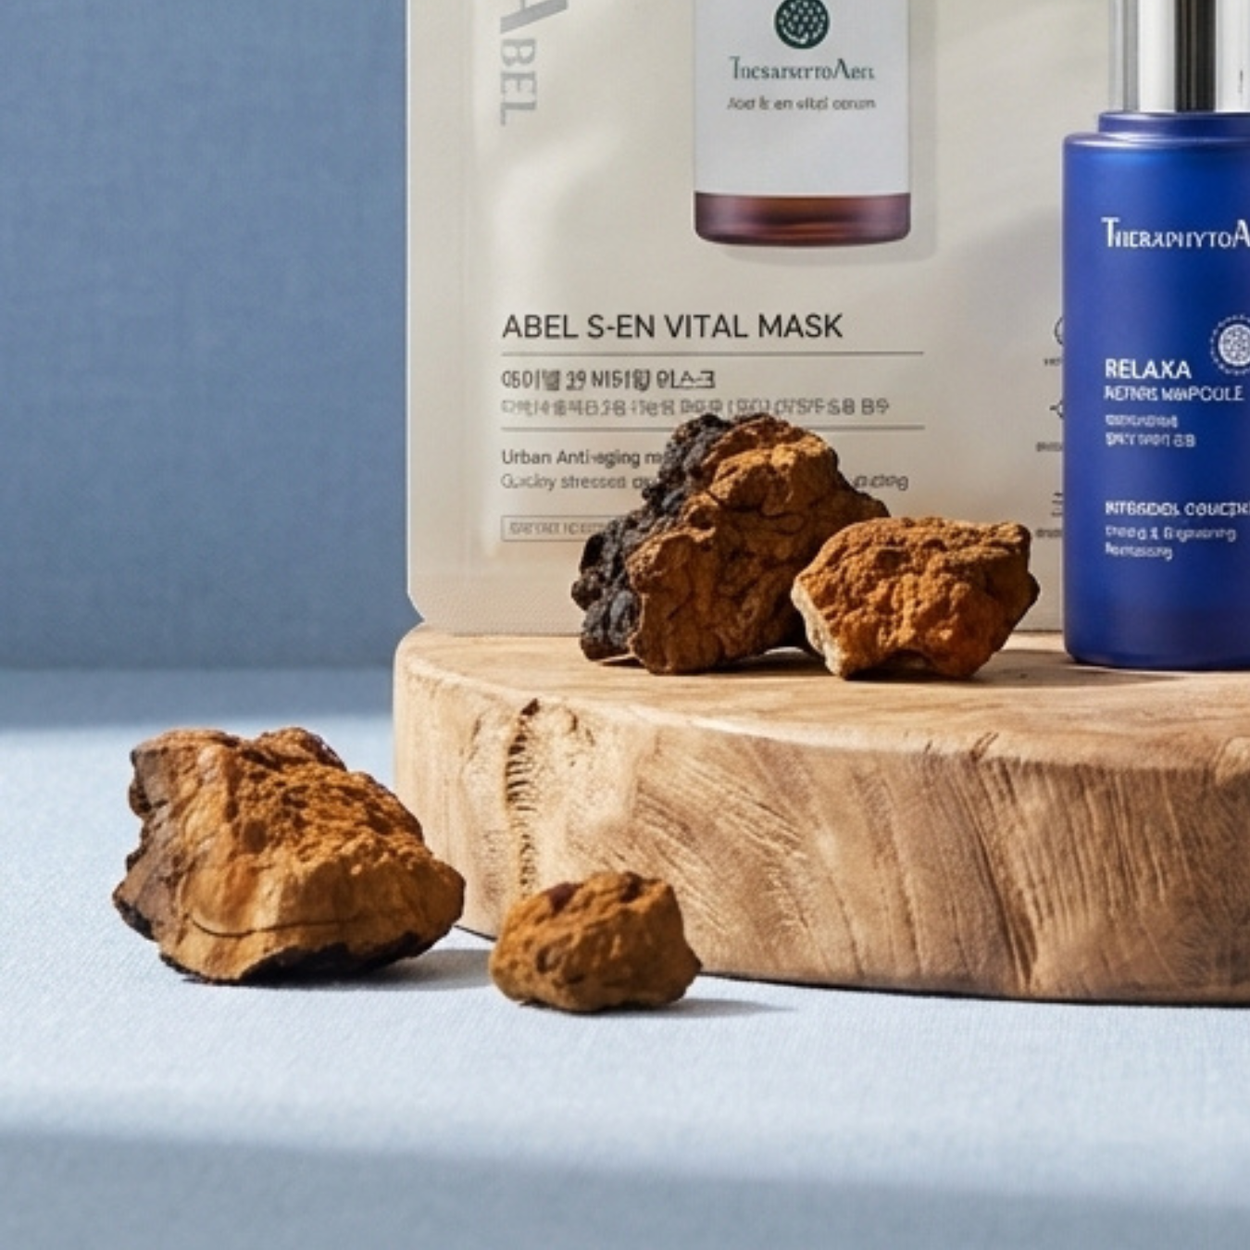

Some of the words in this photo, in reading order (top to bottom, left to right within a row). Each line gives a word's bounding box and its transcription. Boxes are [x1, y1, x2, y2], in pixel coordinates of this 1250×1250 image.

[502, 314, 579, 339] ABEL
[586, 314, 656, 339] S-EN
[664, 314, 748, 339] VITAL
[758, 314, 843, 339] MASK
[1105, 358, 1192, 380] RELAXA
[502, 450, 550, 465] Urban
